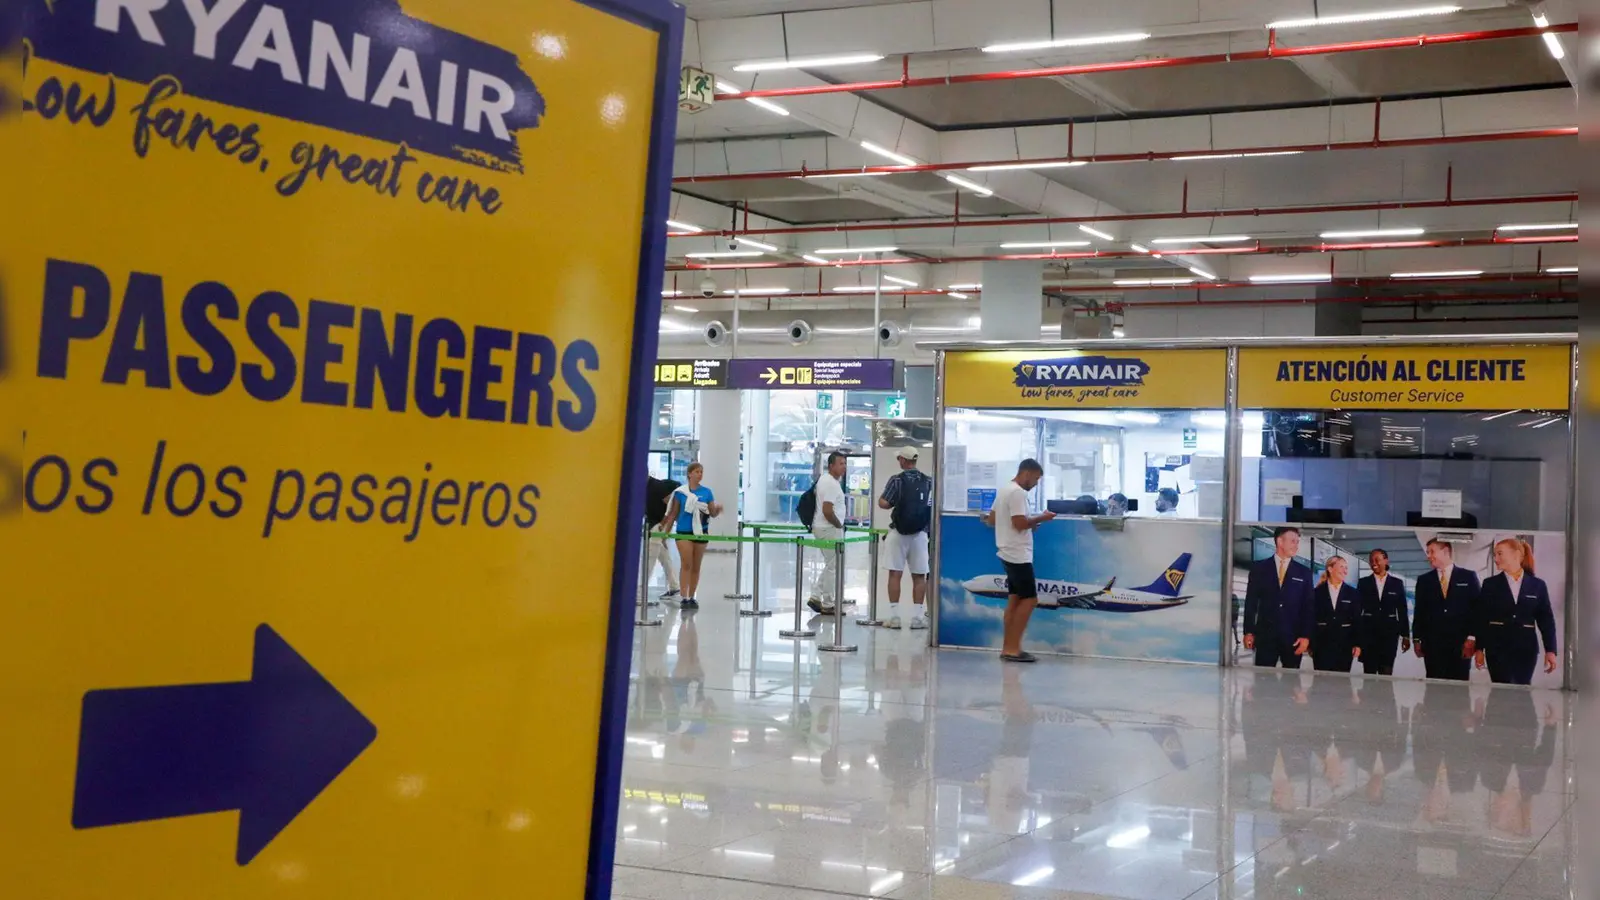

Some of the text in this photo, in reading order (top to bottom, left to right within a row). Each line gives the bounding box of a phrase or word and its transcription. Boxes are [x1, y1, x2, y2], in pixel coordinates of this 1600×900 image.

[131, 78, 268, 174] fares,
[275, 142, 417, 197] great
[416, 170, 503, 215] care
[36, 257, 599, 433] PASSENGERS
[1036, 364, 1141, 380] RYANAIR
[1276, 354, 1526, 382] ATENCIÓN AL CLIENTE
[1021, 385, 1139, 403] Low fares, great care
[1330, 388, 1466, 403] Customer Service
[141, 440, 247, 519] los
[262, 462, 541, 543] pasajeros
